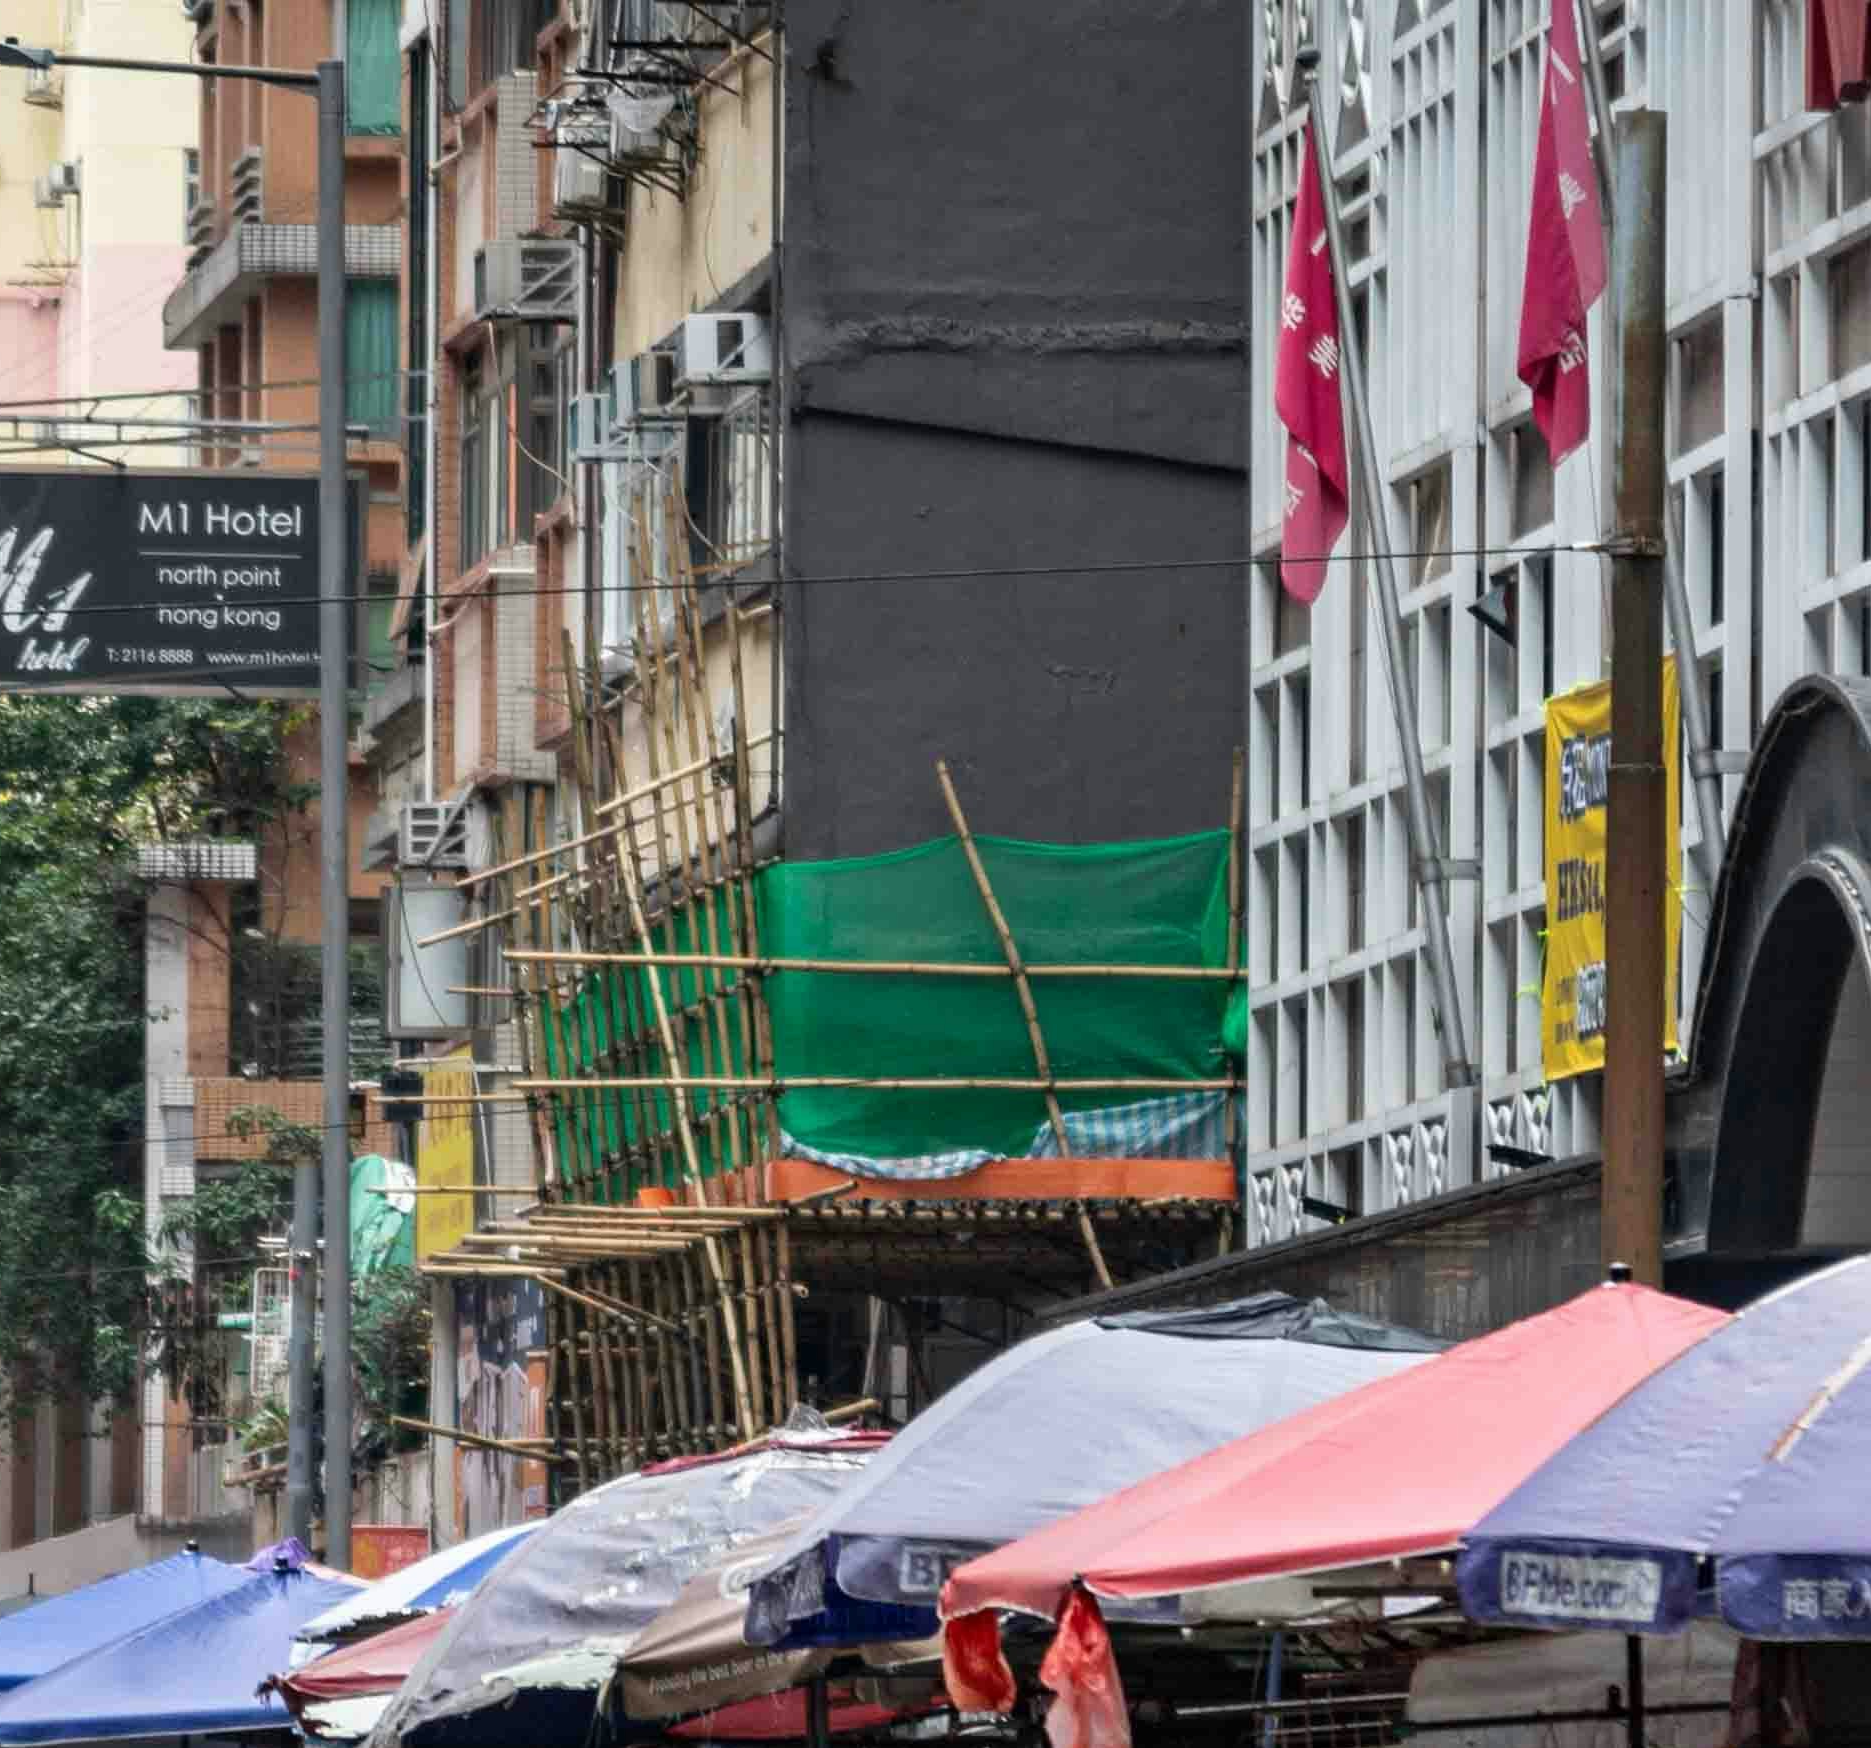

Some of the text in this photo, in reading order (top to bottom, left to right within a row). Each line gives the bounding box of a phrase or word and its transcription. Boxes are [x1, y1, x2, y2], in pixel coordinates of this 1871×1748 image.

[139, 503, 303, 537] M1 Hotel
[158, 564, 281, 590] north point
[17, 637, 91, 671] hotel
[122, 648, 156, 664] 2116
[158, 648, 194, 665] 8888
